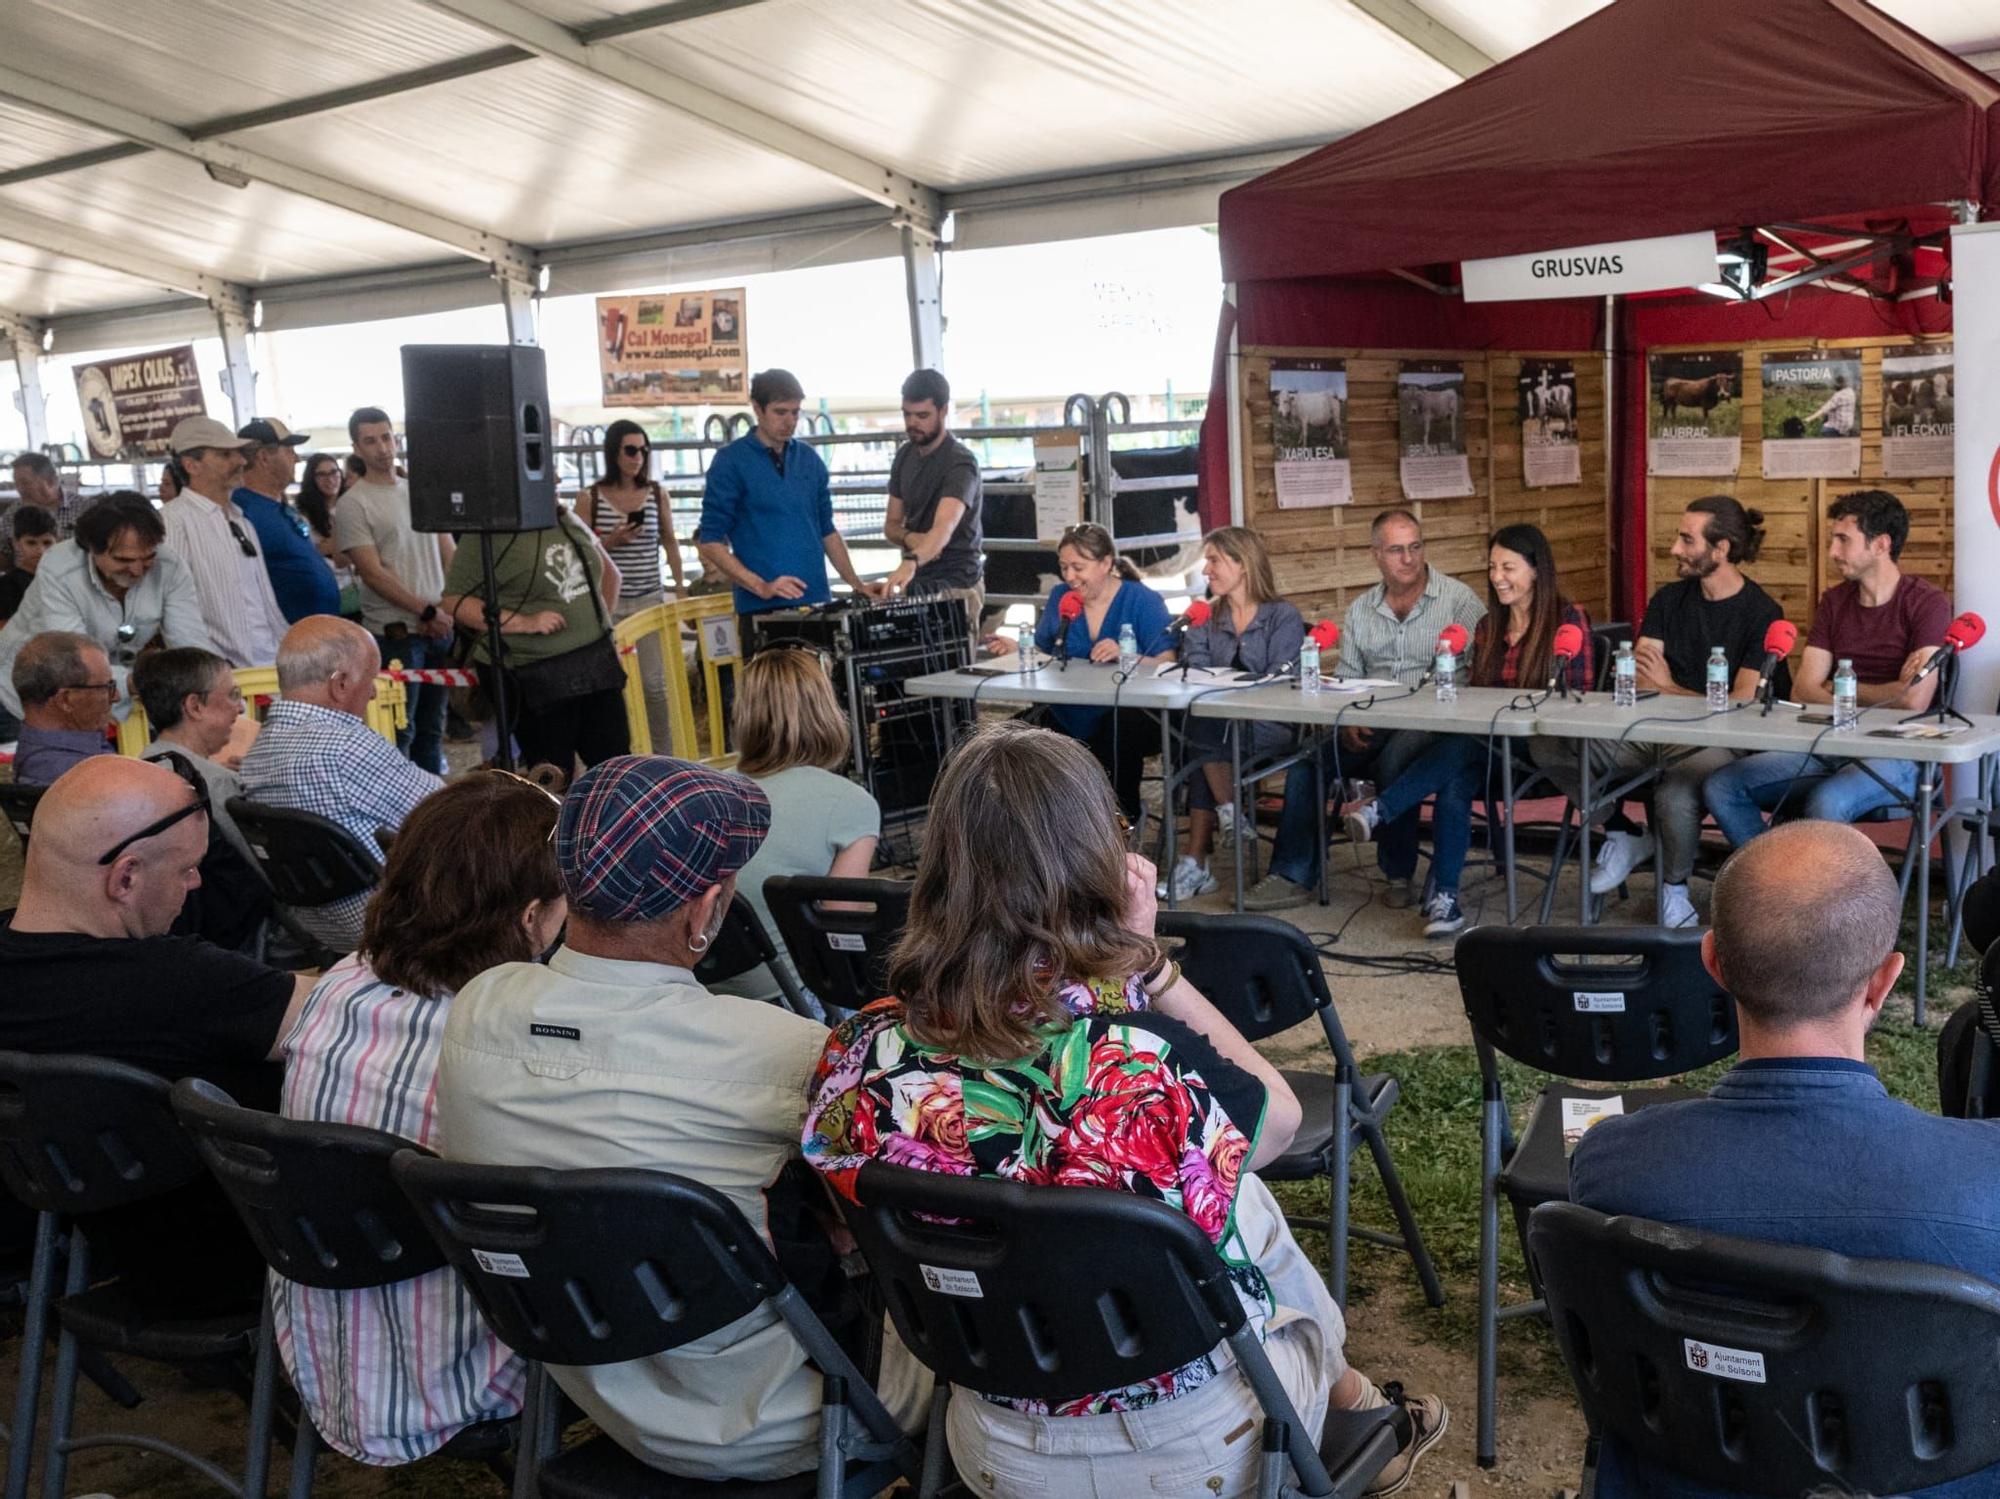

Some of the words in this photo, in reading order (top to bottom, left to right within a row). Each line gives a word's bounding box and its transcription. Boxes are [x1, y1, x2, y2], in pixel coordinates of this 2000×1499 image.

[1531, 255, 1624, 279] GRUSVAS
[628, 330, 647, 347] Cal
[651, 328, 708, 348] Monegal
[625, 346, 741, 361] www.calmonegal.com
[110, 360, 144, 392] IMPEX
[1775, 367, 1831, 382] PASTOR/A
[1662, 426, 1709, 440] AUBRAC
[1284, 446, 1335, 461] XAROLESA
[1714, 1351, 1760, 1367] Ajuntament
[1715, 1363, 1725, 1372] de
[1727, 1365, 1761, 1378] Solsona
